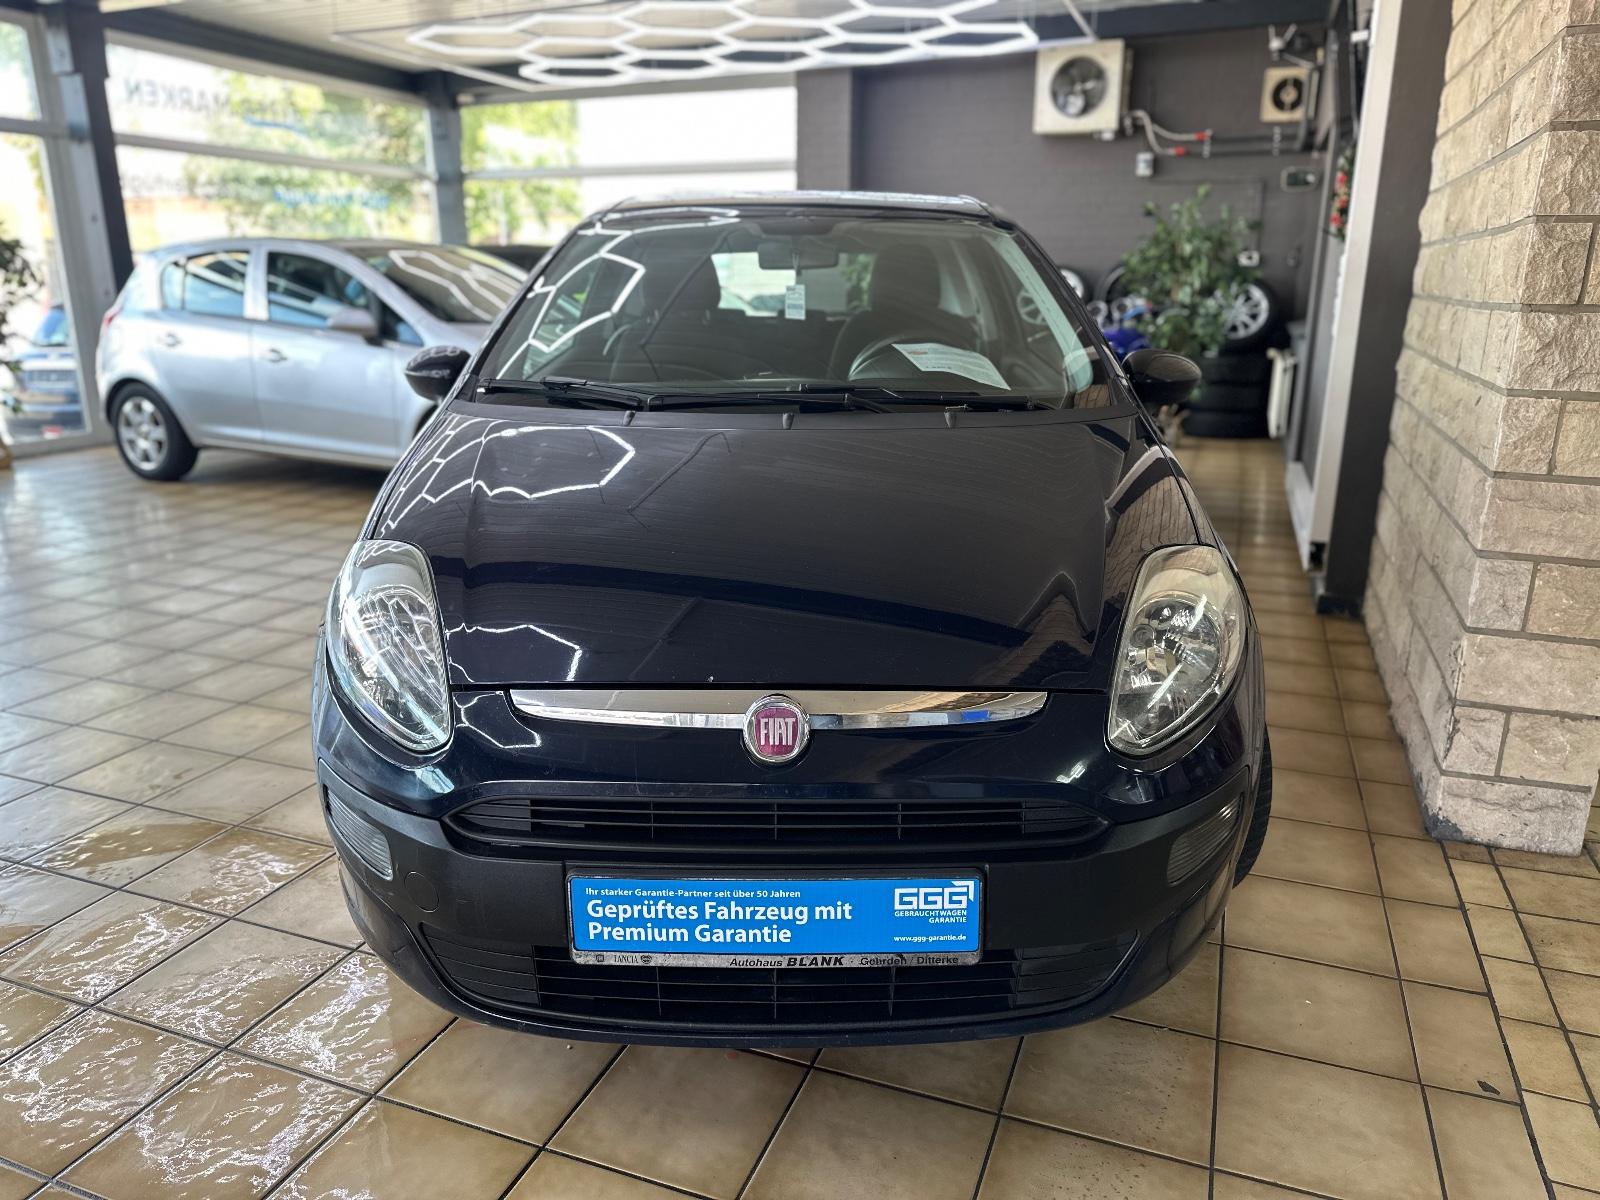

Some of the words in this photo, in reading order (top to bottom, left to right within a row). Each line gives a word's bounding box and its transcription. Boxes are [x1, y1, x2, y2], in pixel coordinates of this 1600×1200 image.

[760, 717, 796, 746] FIAT
[585, 887, 599, 896] Ihr
[600, 887, 633, 897] starker
[634, 888, 713, 898] Garantie-Partner
[714, 889, 731, 898] seit
[732, 889, 755, 898] über
[756, 890, 769, 898] 50
[769, 890, 801, 898] Jahren
[894, 887, 968, 910] GGG
[586, 899, 699, 923] Geprüftes
[704, 901, 809, 925] Fahrzeug
[814, 901, 853, 920] mit
[894, 909, 968, 917] GEBRAUCHTWAGEN
[928, 916, 968, 924] GARANTIE
[588, 921, 689, 942] Premium
[694, 924, 792, 943] Garantie
[893, 934, 967, 943] www.ggg-garantie.de
[729, 958, 783, 967] Autohaus
[786, 956, 845, 967] BLANK
[917, 955, 959, 965] Ditterke
